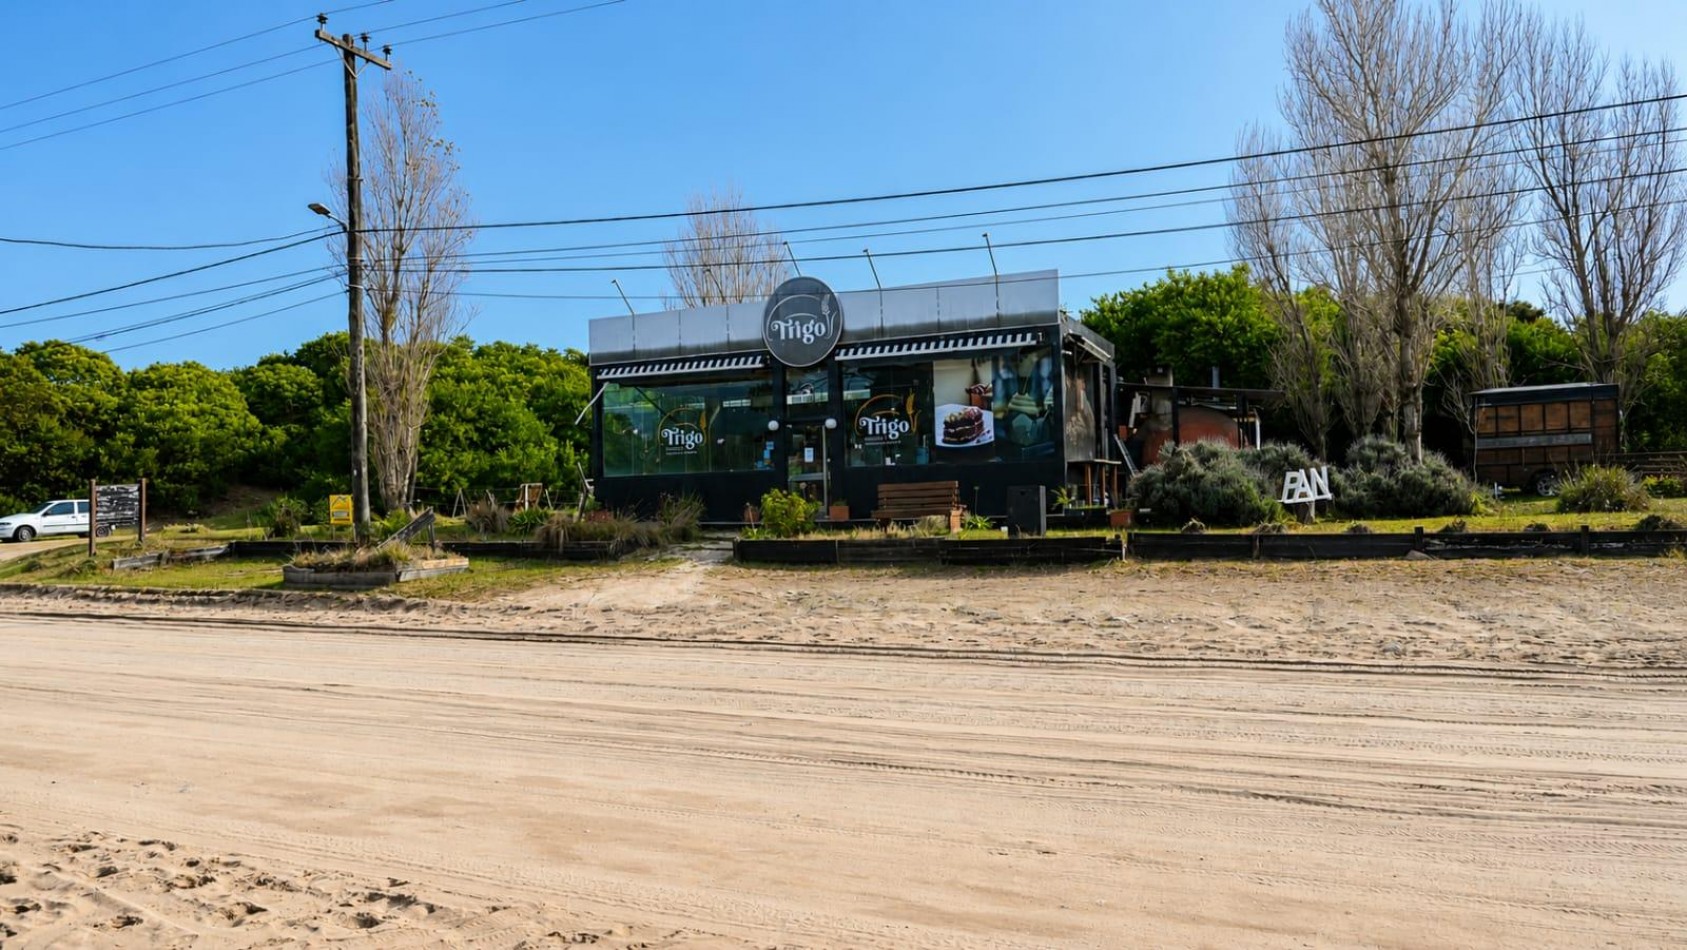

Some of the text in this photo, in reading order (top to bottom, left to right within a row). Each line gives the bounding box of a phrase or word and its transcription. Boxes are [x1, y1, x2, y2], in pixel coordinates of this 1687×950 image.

[770, 318, 826, 345] Trigo
[661, 427, 703, 450] Trigo
[858, 415, 910, 440] Trigo
[1281, 465, 1332, 503] PAN
